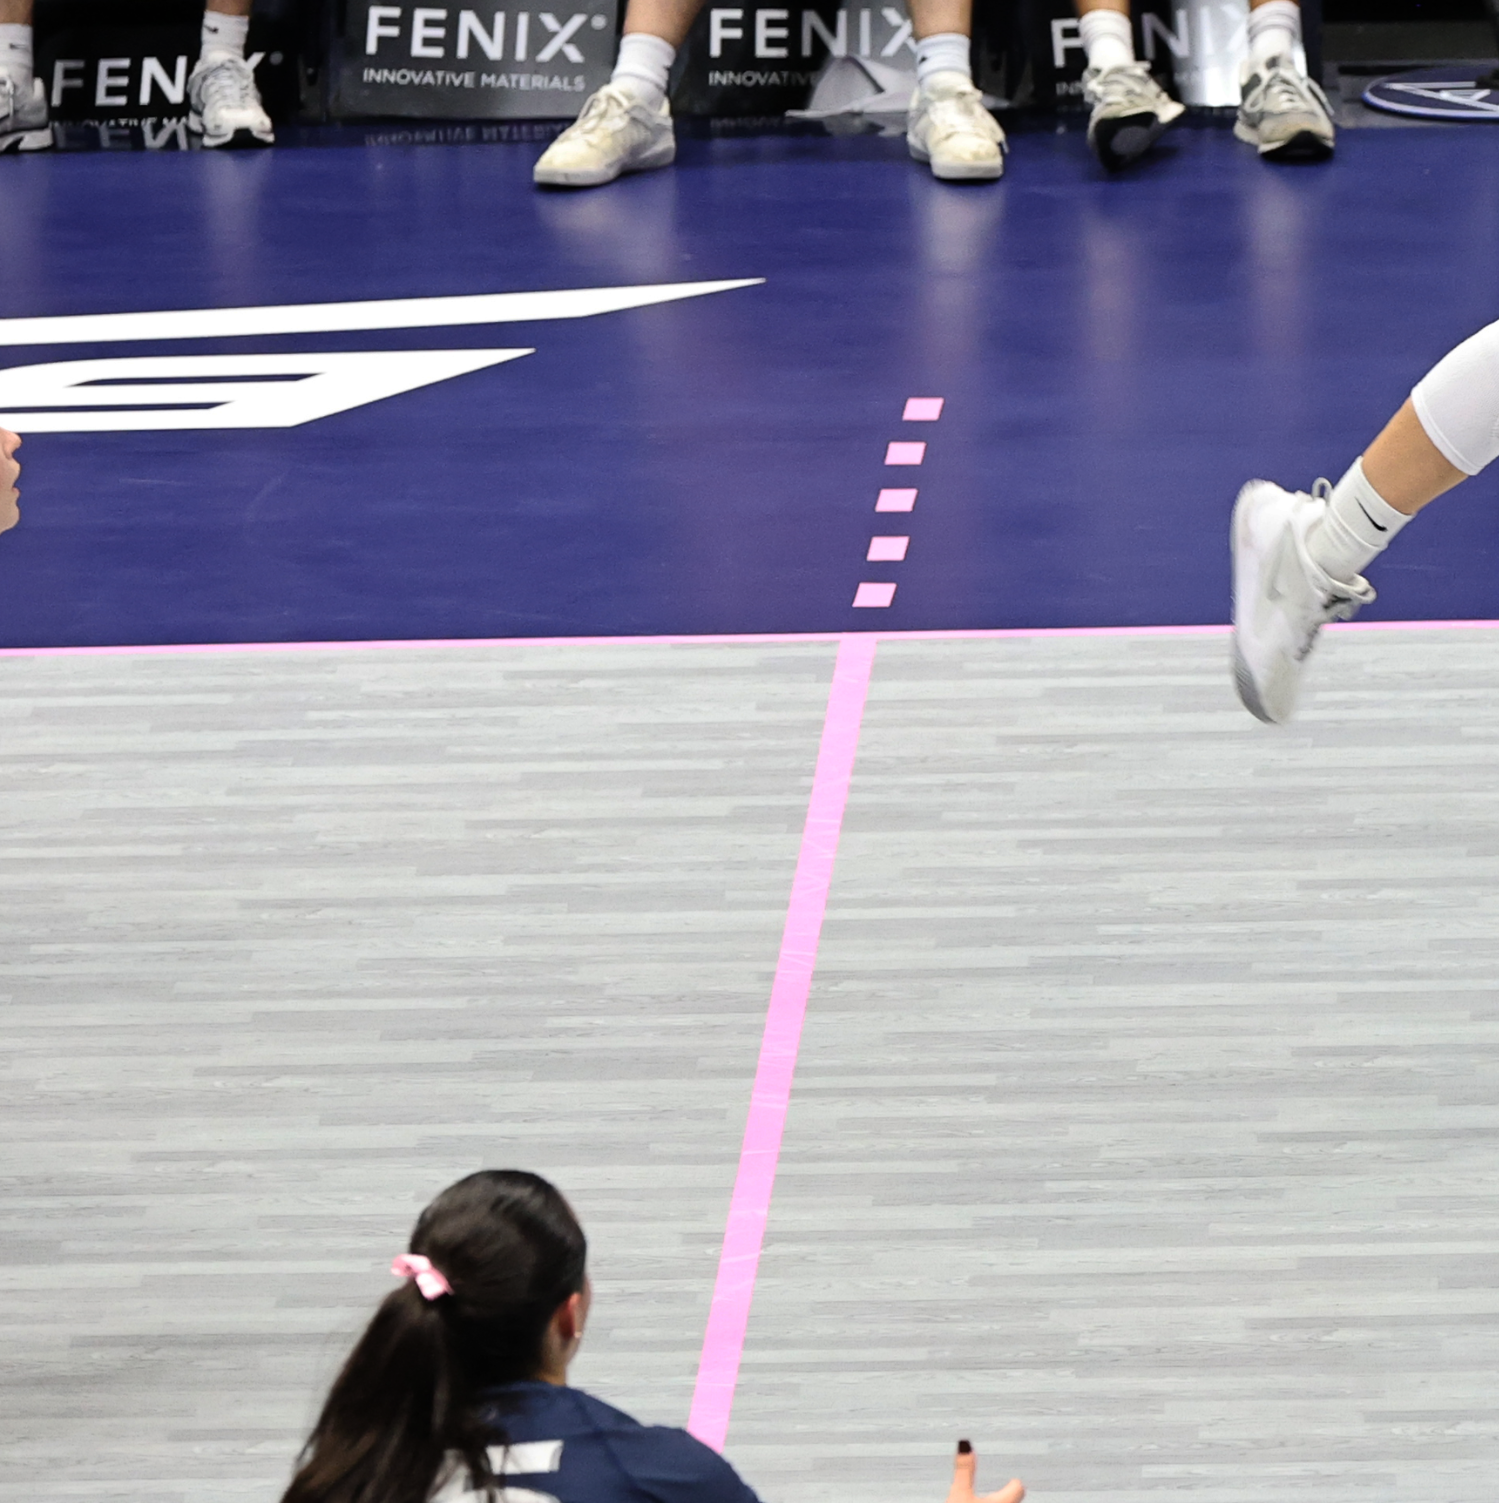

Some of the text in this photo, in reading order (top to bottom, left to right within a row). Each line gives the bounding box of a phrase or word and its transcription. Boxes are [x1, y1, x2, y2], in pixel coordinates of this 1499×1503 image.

[365, 5, 589, 64] FENIX
[362, 67, 586, 92] INNOVATIVE MATERIALS
